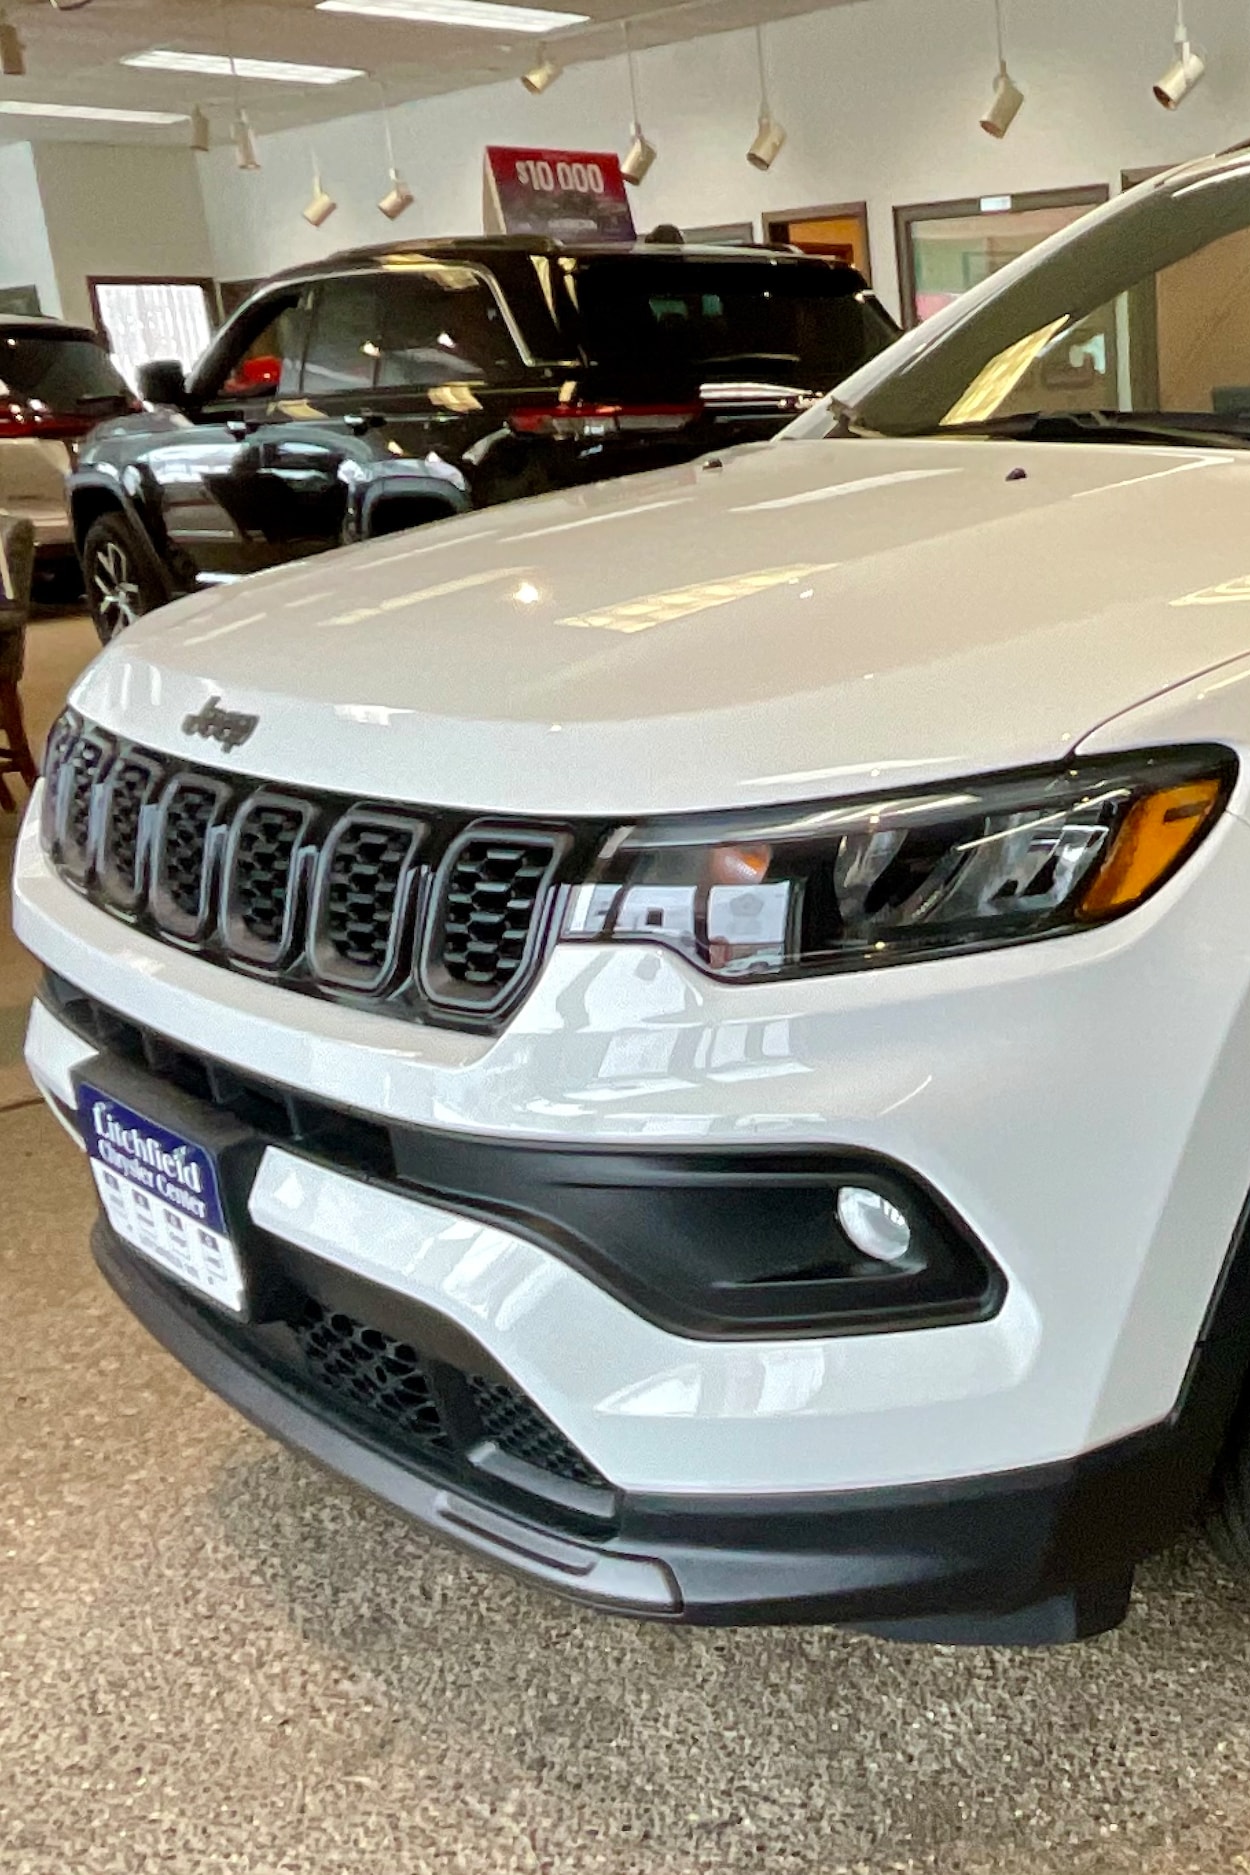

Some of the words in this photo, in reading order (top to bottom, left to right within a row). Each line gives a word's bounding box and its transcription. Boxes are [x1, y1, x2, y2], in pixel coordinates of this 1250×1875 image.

[92, 1101, 202, 1194] Litchfield
[97, 1139, 154, 1189] Chrysler
[155, 1173, 207, 1219] Center
